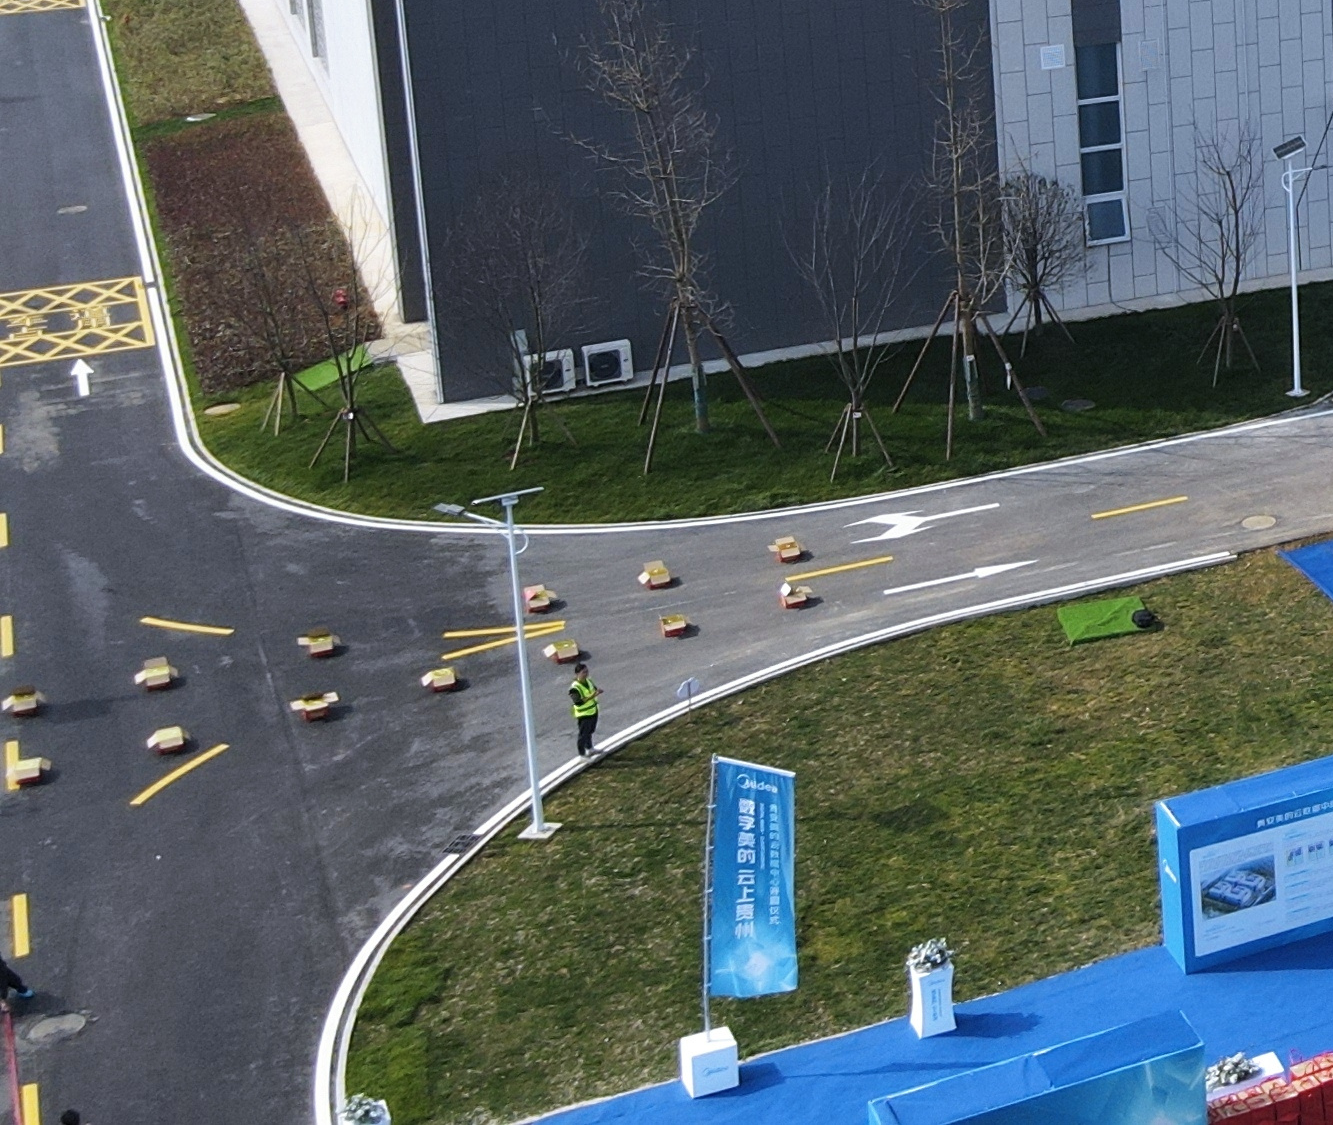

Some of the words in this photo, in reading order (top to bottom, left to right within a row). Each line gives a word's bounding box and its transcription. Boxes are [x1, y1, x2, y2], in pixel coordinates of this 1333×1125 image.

[736, 773, 778, 794] Midea
[737, 797, 756, 863] 数字美的
[734, 868, 756, 940] 云上贵州
